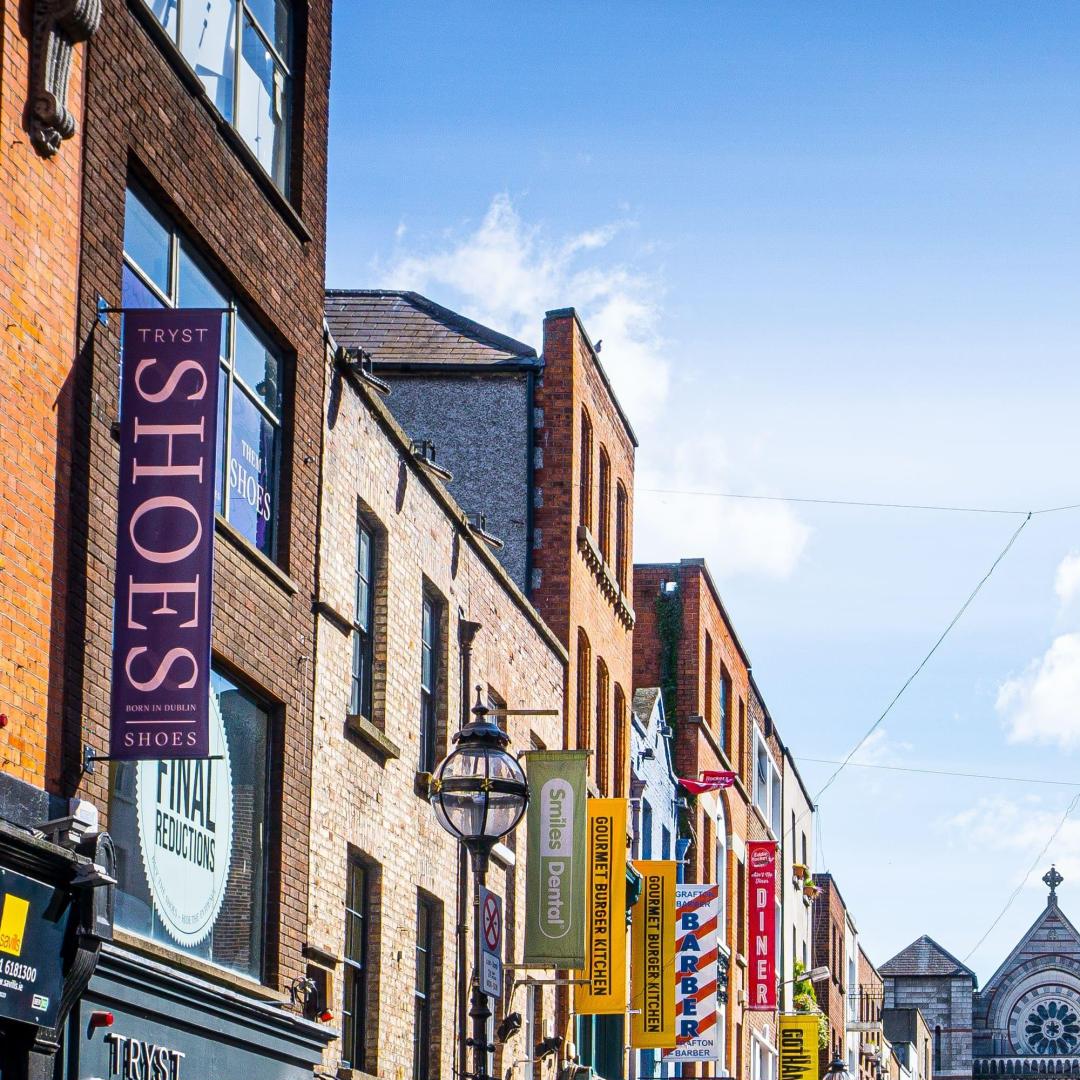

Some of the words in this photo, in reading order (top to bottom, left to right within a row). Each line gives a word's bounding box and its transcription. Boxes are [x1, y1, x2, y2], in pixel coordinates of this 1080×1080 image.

[138, 328, 208, 343] TRYST
[230, 458, 271, 521] SHOES
[125, 358, 208, 693] SHOES
[126, 703, 150, 713] BORN
[152, 703, 162, 713] IN
[164, 703, 197, 713] DUBLIN
[124, 731, 197, 747] SHOES
[157, 759, 216, 832] FINAL
[549, 789, 566, 850] Smiles
[155, 809, 216, 872] REDUCTIONS
[595, 816, 609, 879] GOURMET
[547, 862, 564, 924] Dental
[594, 883, 609, 936] BURGER
[646, 876, 660, 933] GOURMET
[4, 960, 37, 983] 6181300
[592, 939, 608, 996] KITCHEN
[646, 936, 660, 982] BURGER
[680, 912, 701, 1037] BARBER
[756, 889, 768, 1004] DINER
[646, 985, 659, 1032] KITCHEN
[675, 1049, 710, 1057] BARBER
